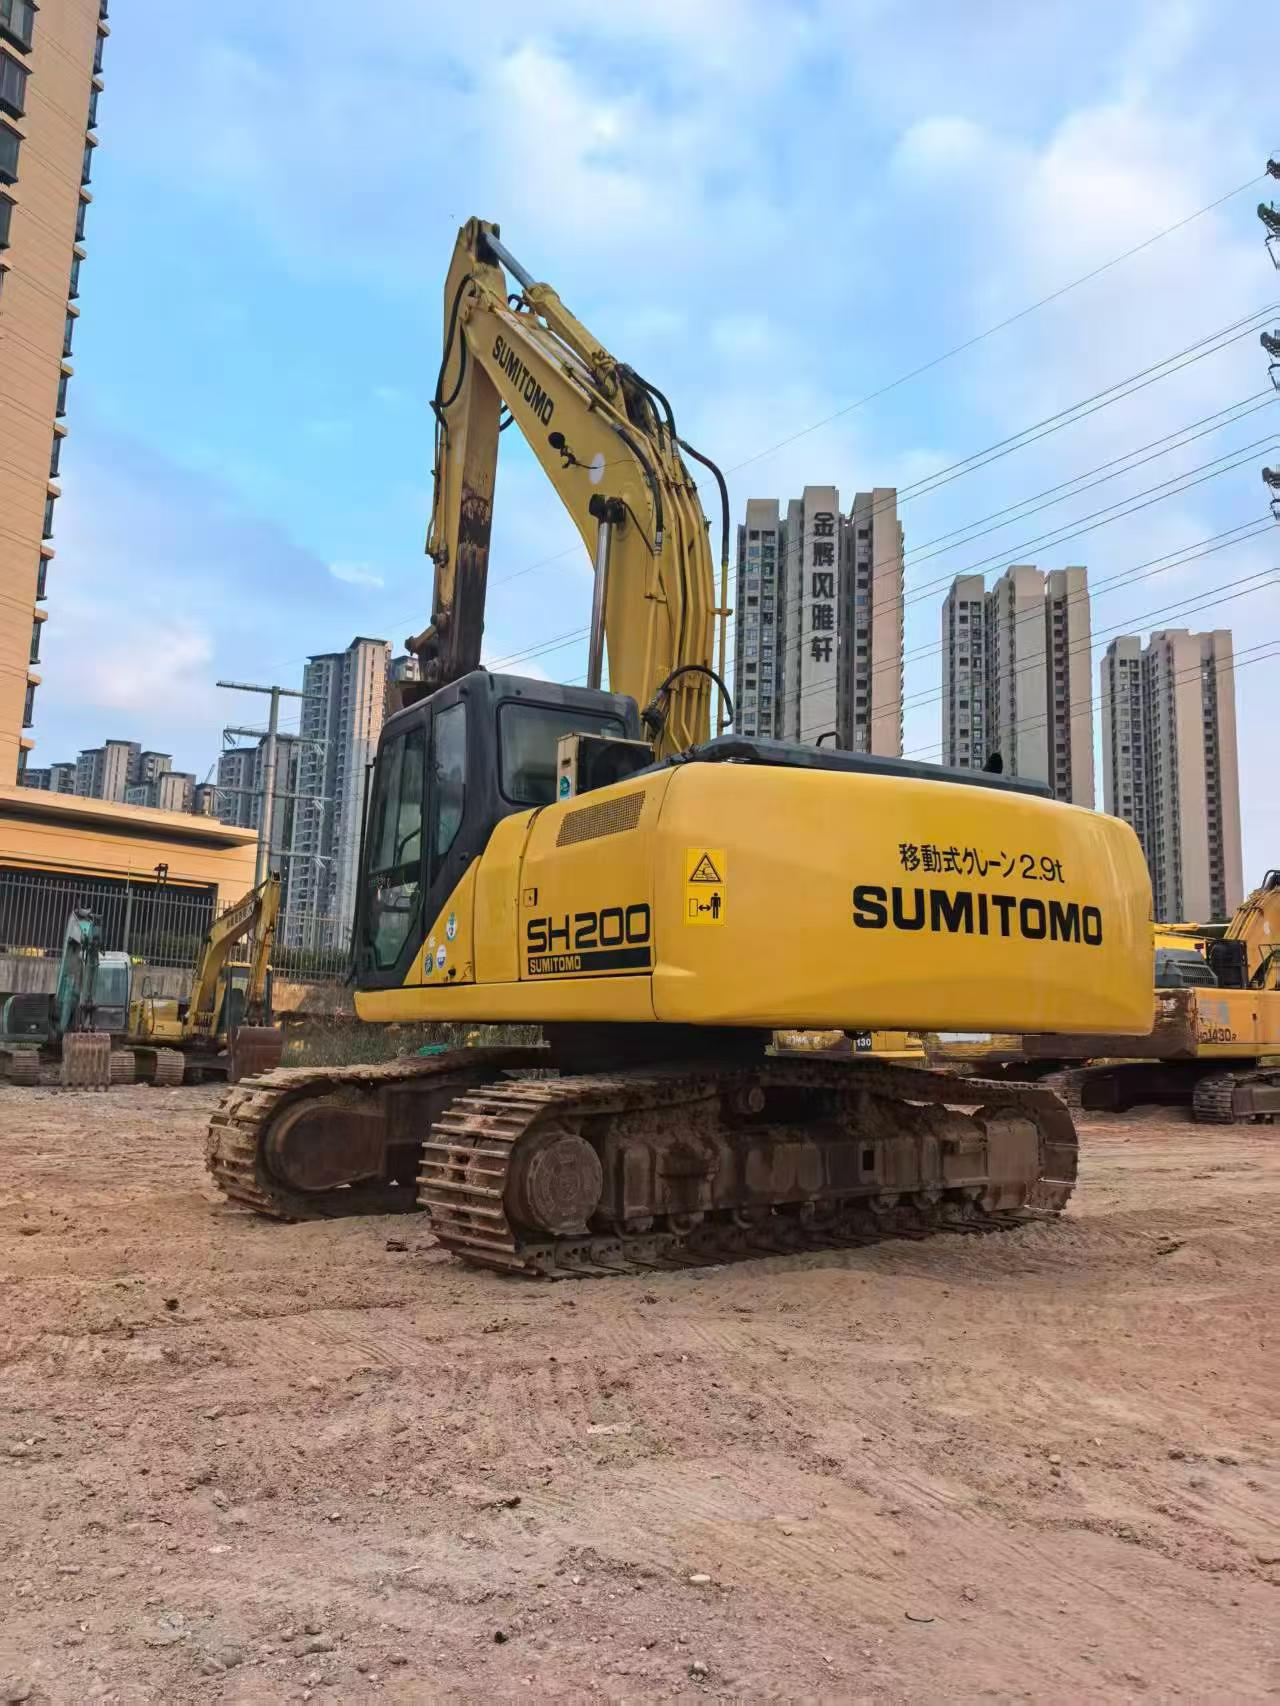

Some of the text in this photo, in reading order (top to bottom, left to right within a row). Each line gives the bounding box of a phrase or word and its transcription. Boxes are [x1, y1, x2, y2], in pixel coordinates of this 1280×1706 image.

[492, 335, 555, 427] SUMITOMO
[527, 903, 650, 954] SH200
[853, 885, 1103, 946] SUMITOMO
[529, 955, 582, 973] SUMITOMO
